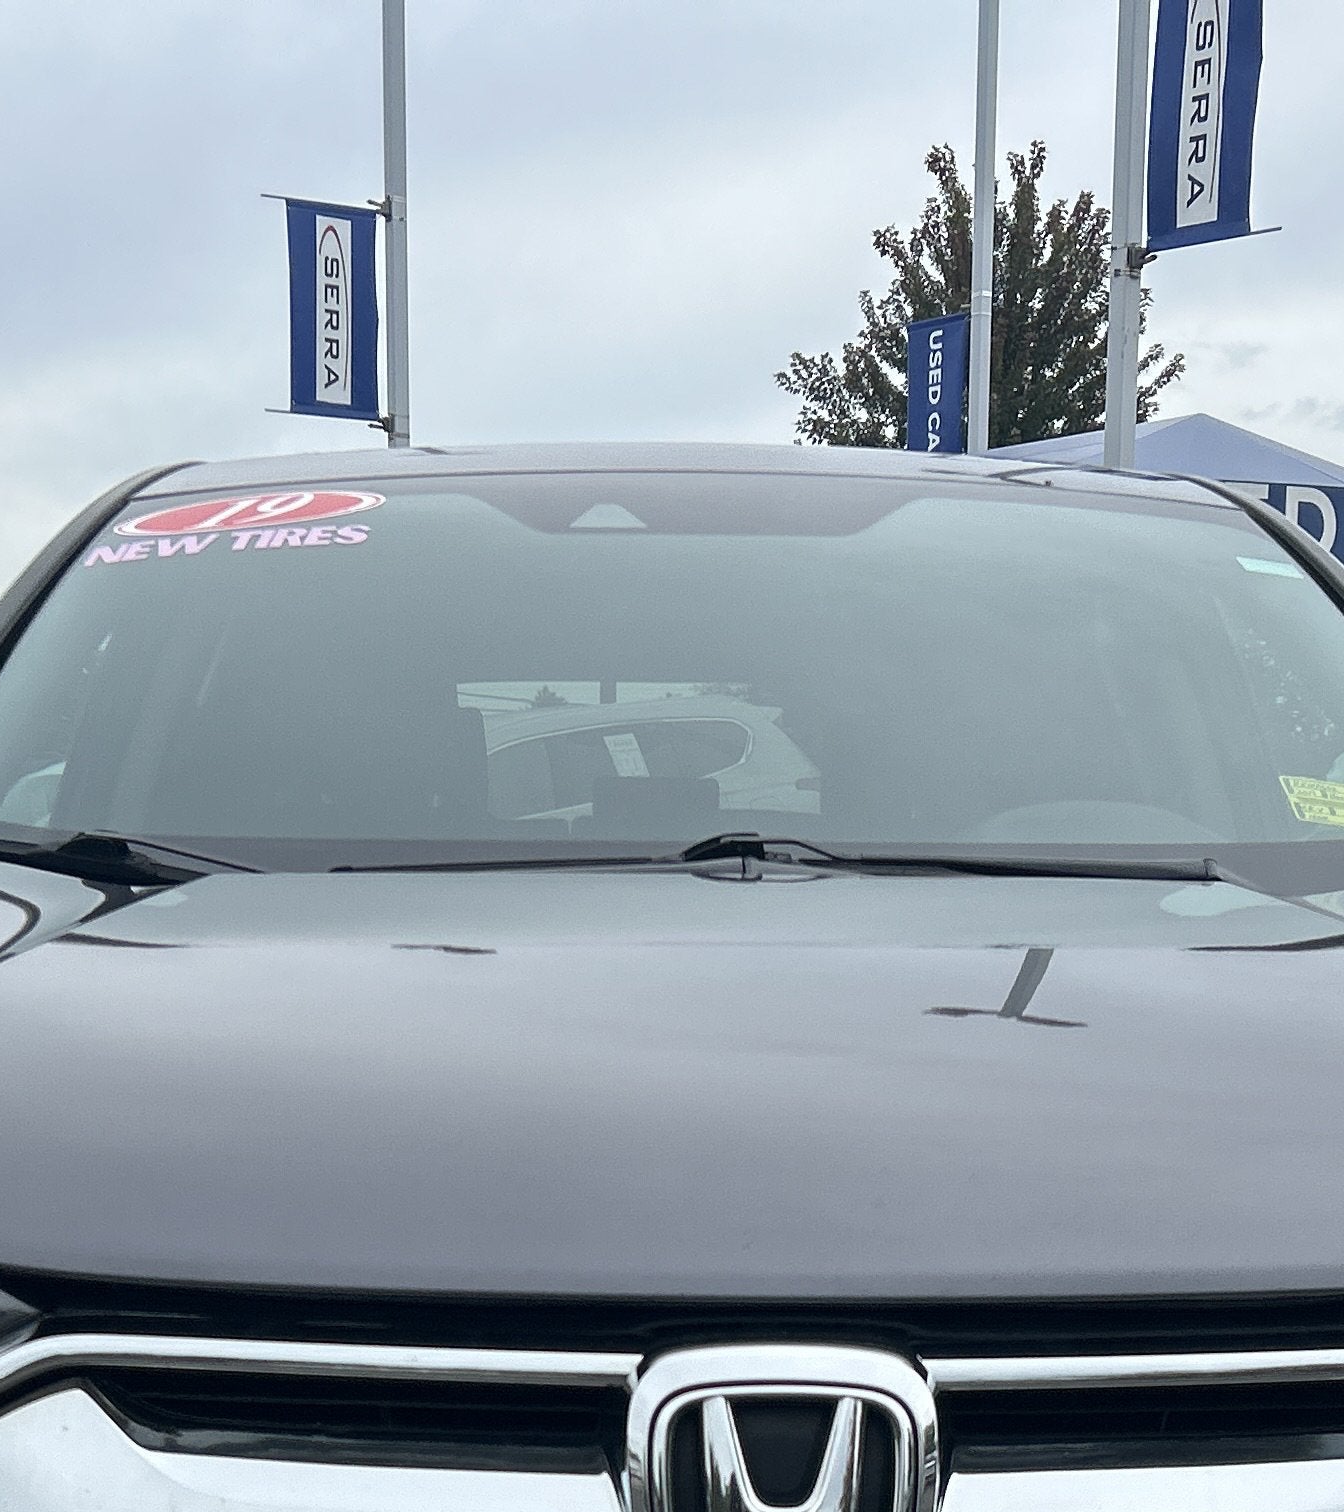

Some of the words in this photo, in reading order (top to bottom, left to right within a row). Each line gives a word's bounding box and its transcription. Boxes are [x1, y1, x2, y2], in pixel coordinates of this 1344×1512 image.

[1186, 19, 1215, 208] SERRA
[323, 255, 340, 389] SERRA
[928, 329, 944, 405] USED
[927, 411, 941, 452] CA
[193, 491, 315, 529] 19
[84, 533, 220, 567] NEW
[230, 524, 372, 551] TIRES
